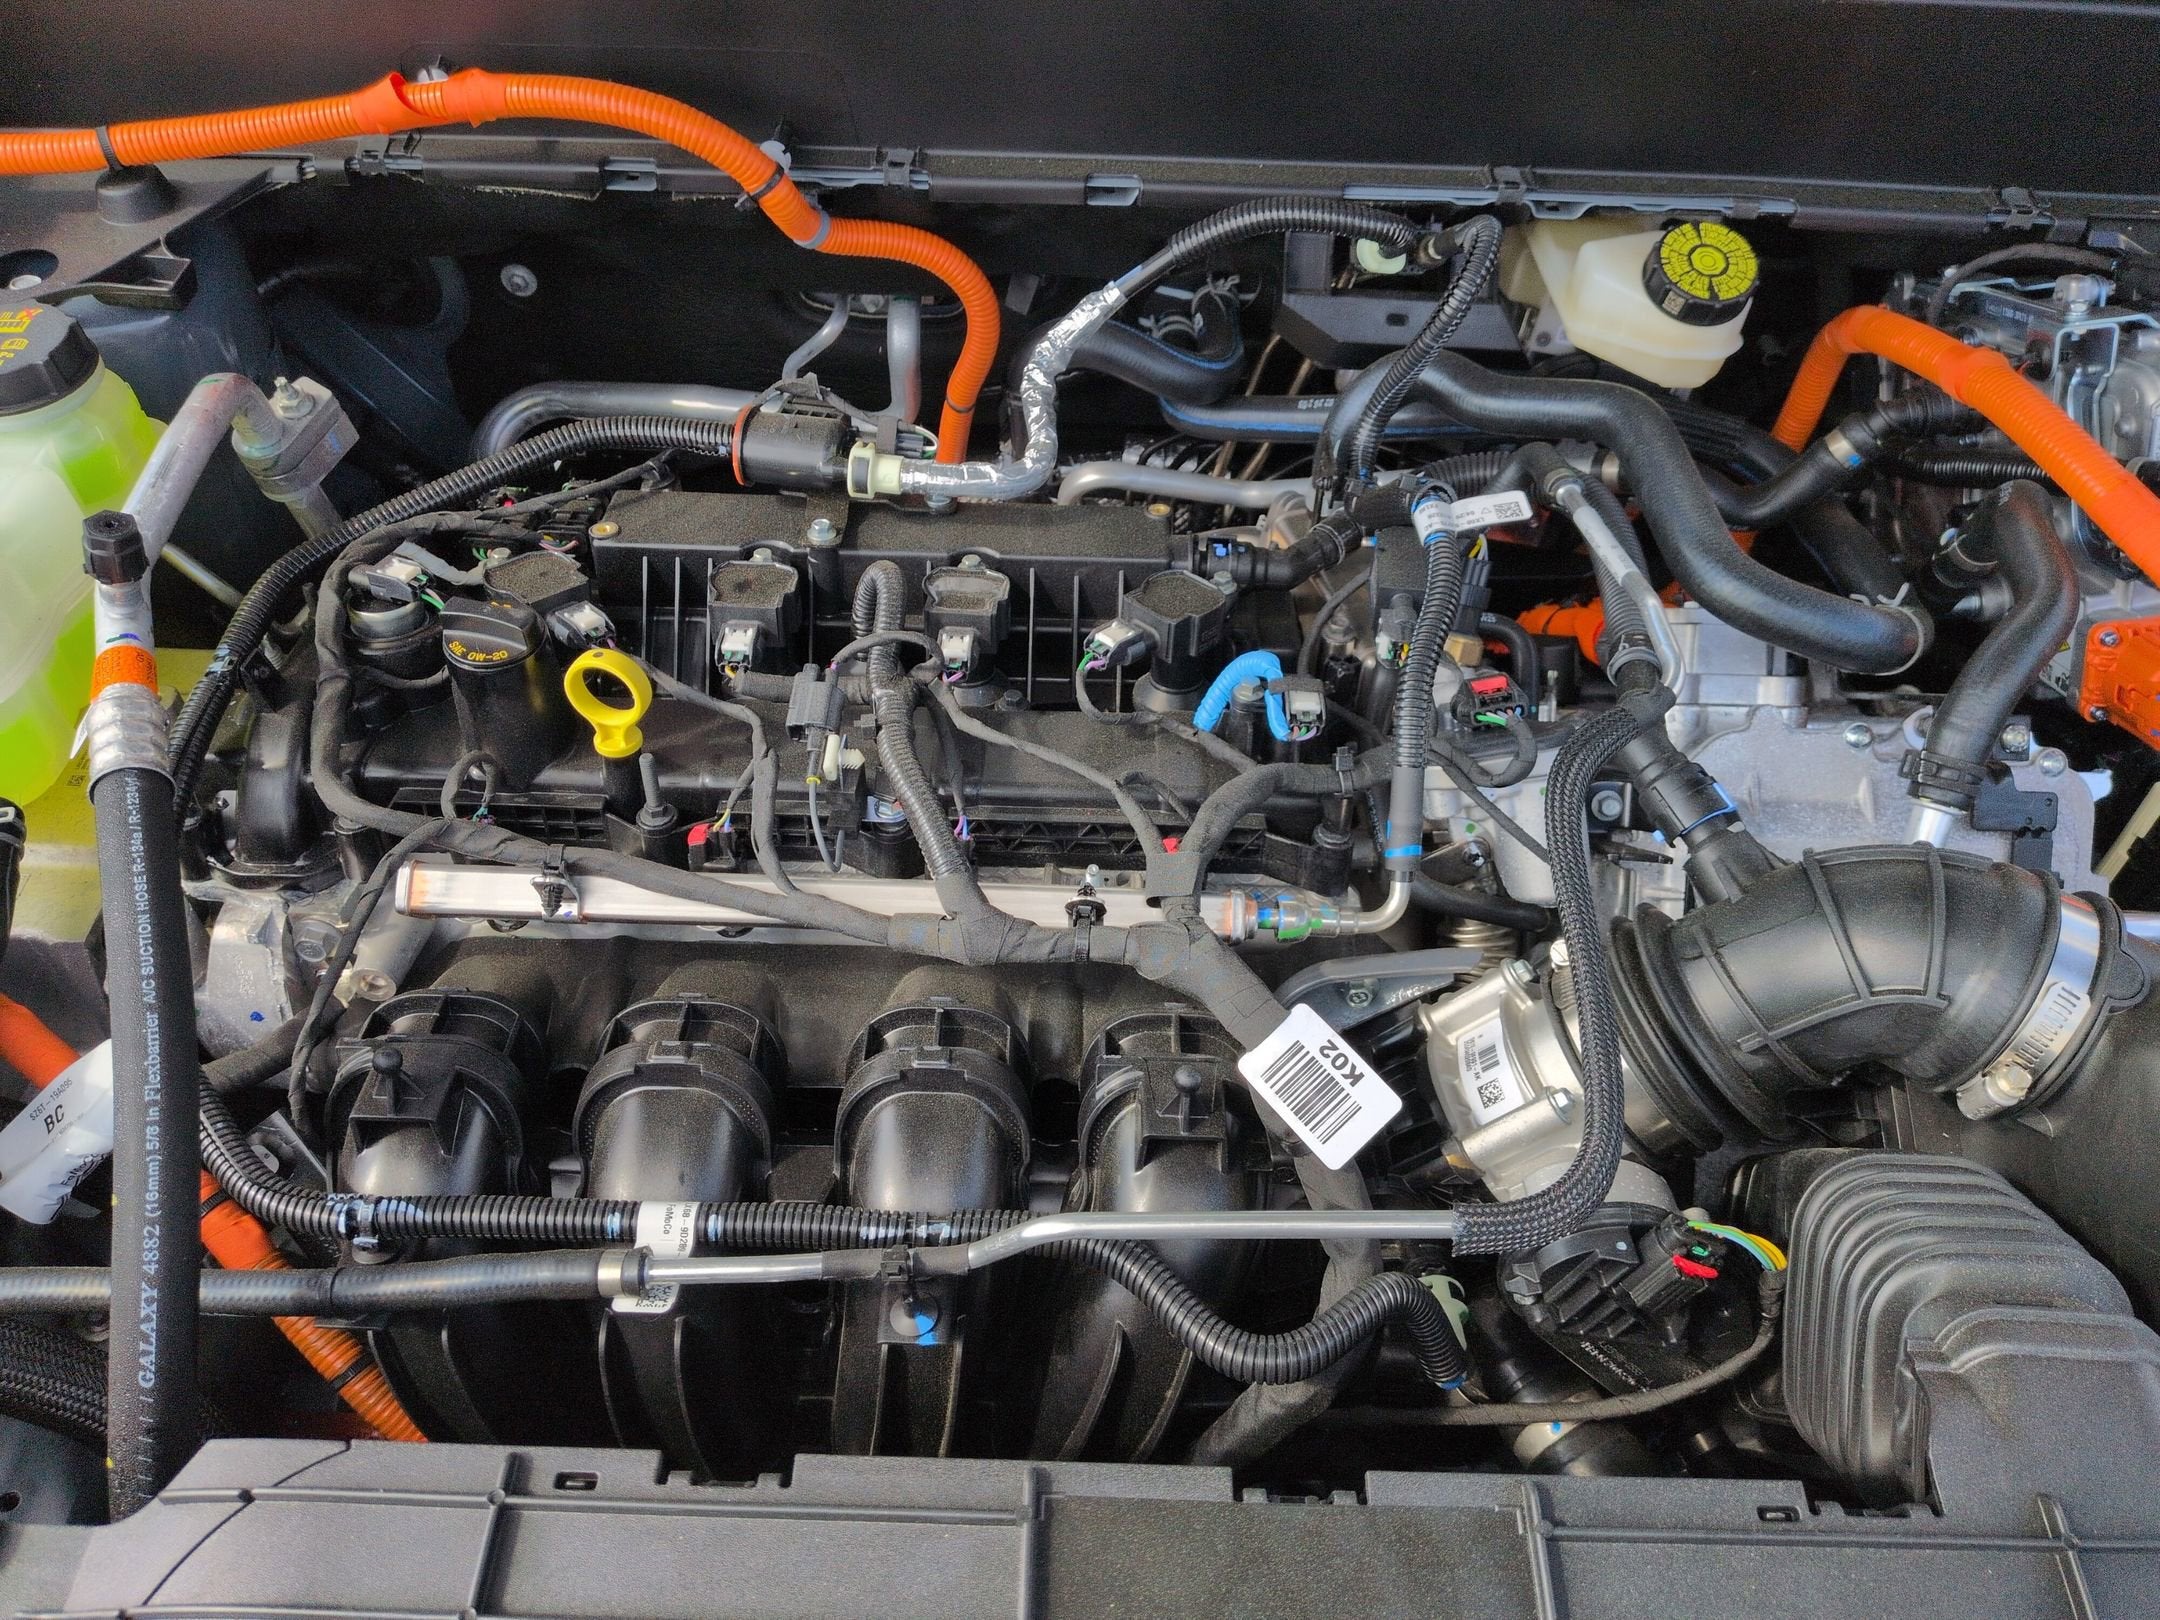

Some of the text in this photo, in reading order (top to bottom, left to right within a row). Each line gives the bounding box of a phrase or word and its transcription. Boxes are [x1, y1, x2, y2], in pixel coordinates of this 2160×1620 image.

[449, 641, 508, 662] SAE 0W-20
[125, 775, 141, 823] R-1234yf
[131, 832, 145, 871] R-134a
[134, 875, 149, 911] HOSE
[137, 914, 155, 976] SUCTION
[142, 979, 156, 1003] A/C
[143, 1012, 161, 1101] Flexbarrier
[1318, 1039, 1365, 1087] K02
[44, 1104, 65, 1134] BC
[146, 1106, 160, 1122] in
[145, 1155, 162, 1217] (16mm)
[663, 1204, 676, 1235] FoMoCo
[143, 1224, 159, 1275] 4882
[138, 1281, 157, 1388] GALAXY
